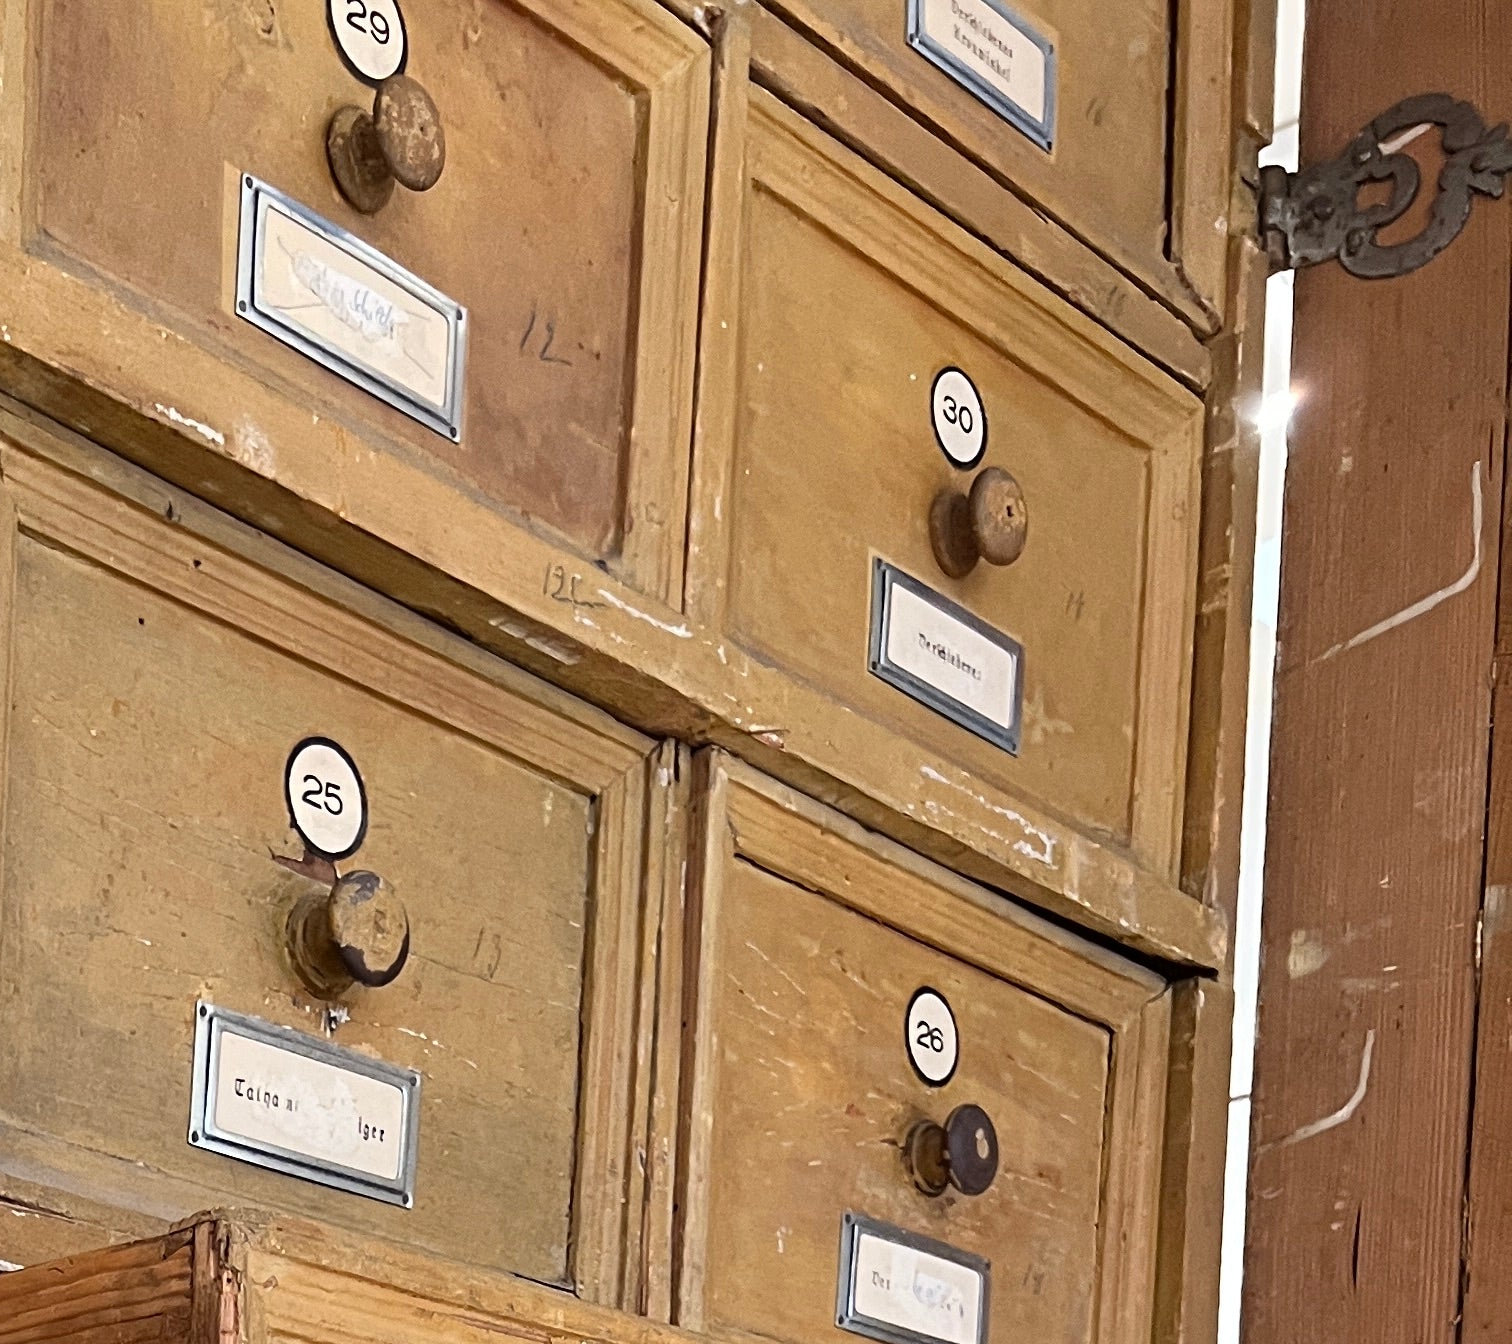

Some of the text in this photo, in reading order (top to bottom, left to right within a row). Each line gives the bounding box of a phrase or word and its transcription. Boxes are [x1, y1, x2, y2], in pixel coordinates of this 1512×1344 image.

[345, 0, 390, 45] 29
[943, 396, 973, 433] 30
[302, 774, 343, 815] 25
[916, 1020, 944, 1053] 26
